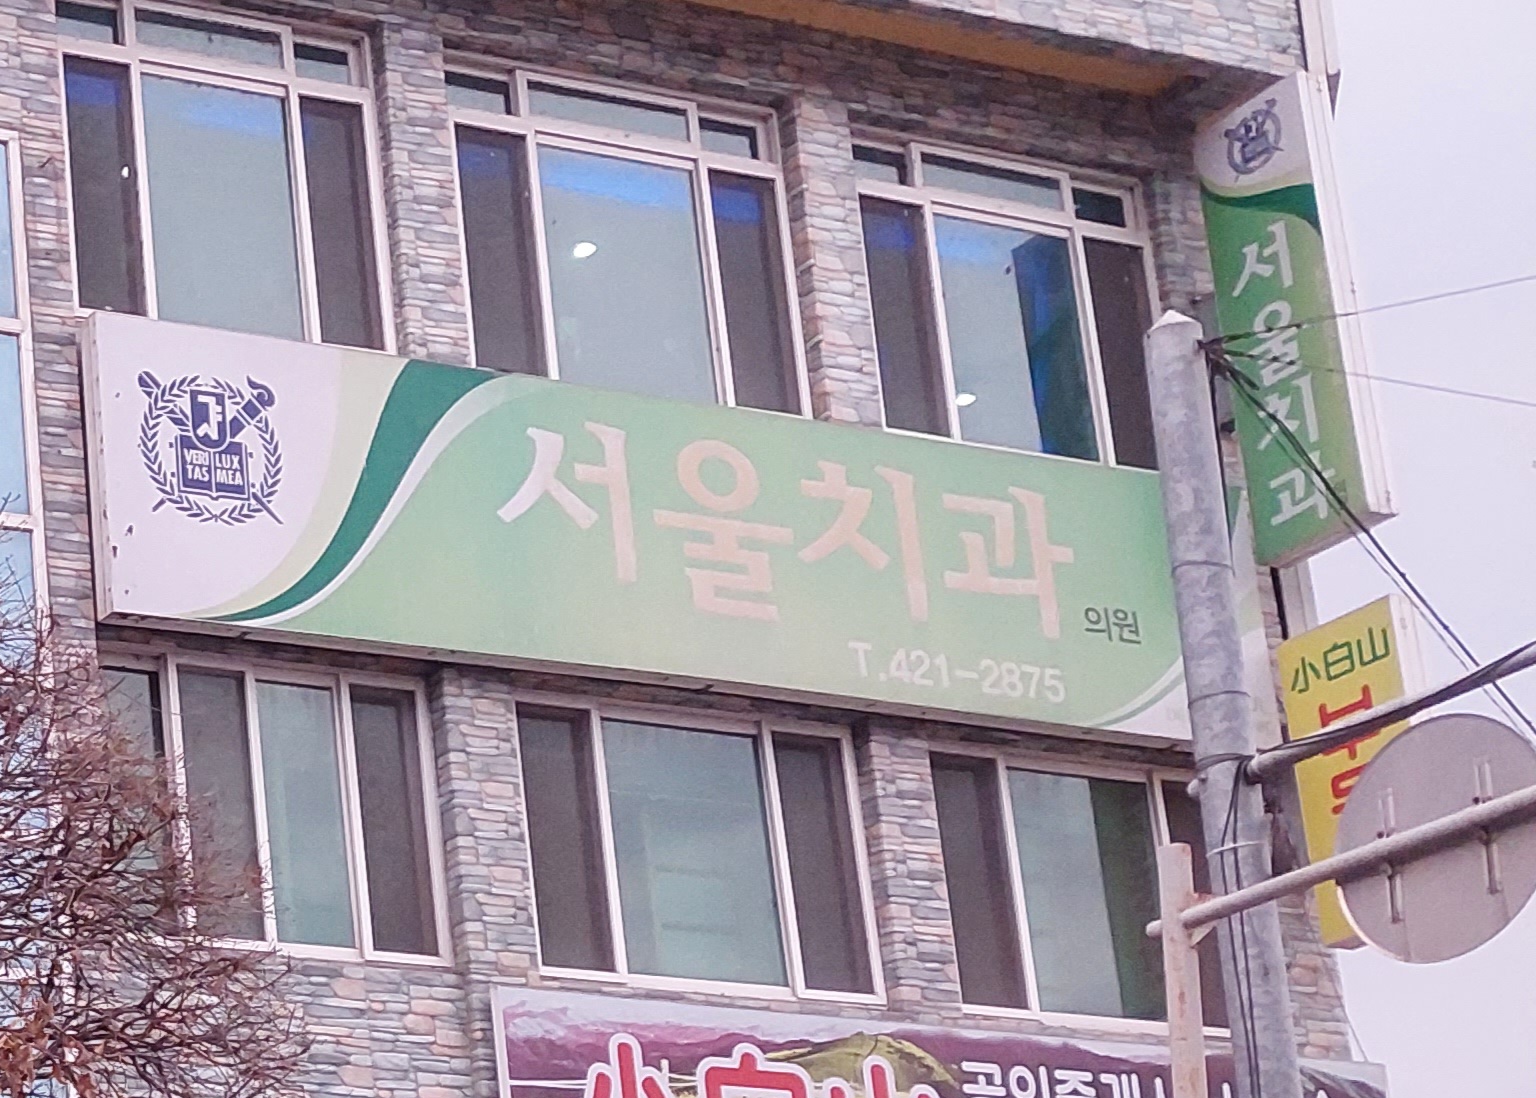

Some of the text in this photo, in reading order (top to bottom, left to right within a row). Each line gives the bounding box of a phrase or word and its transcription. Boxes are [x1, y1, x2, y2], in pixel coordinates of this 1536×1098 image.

[1232, 219, 1336, 527] 서울치과
[187, 465, 210, 483] TAS
[215, 452, 240, 470] LUX
[215, 468, 243, 487] MEA
[495, 421, 1142, 646] 서울치과 의원
[1290, 626, 1391, 694] 小白山
